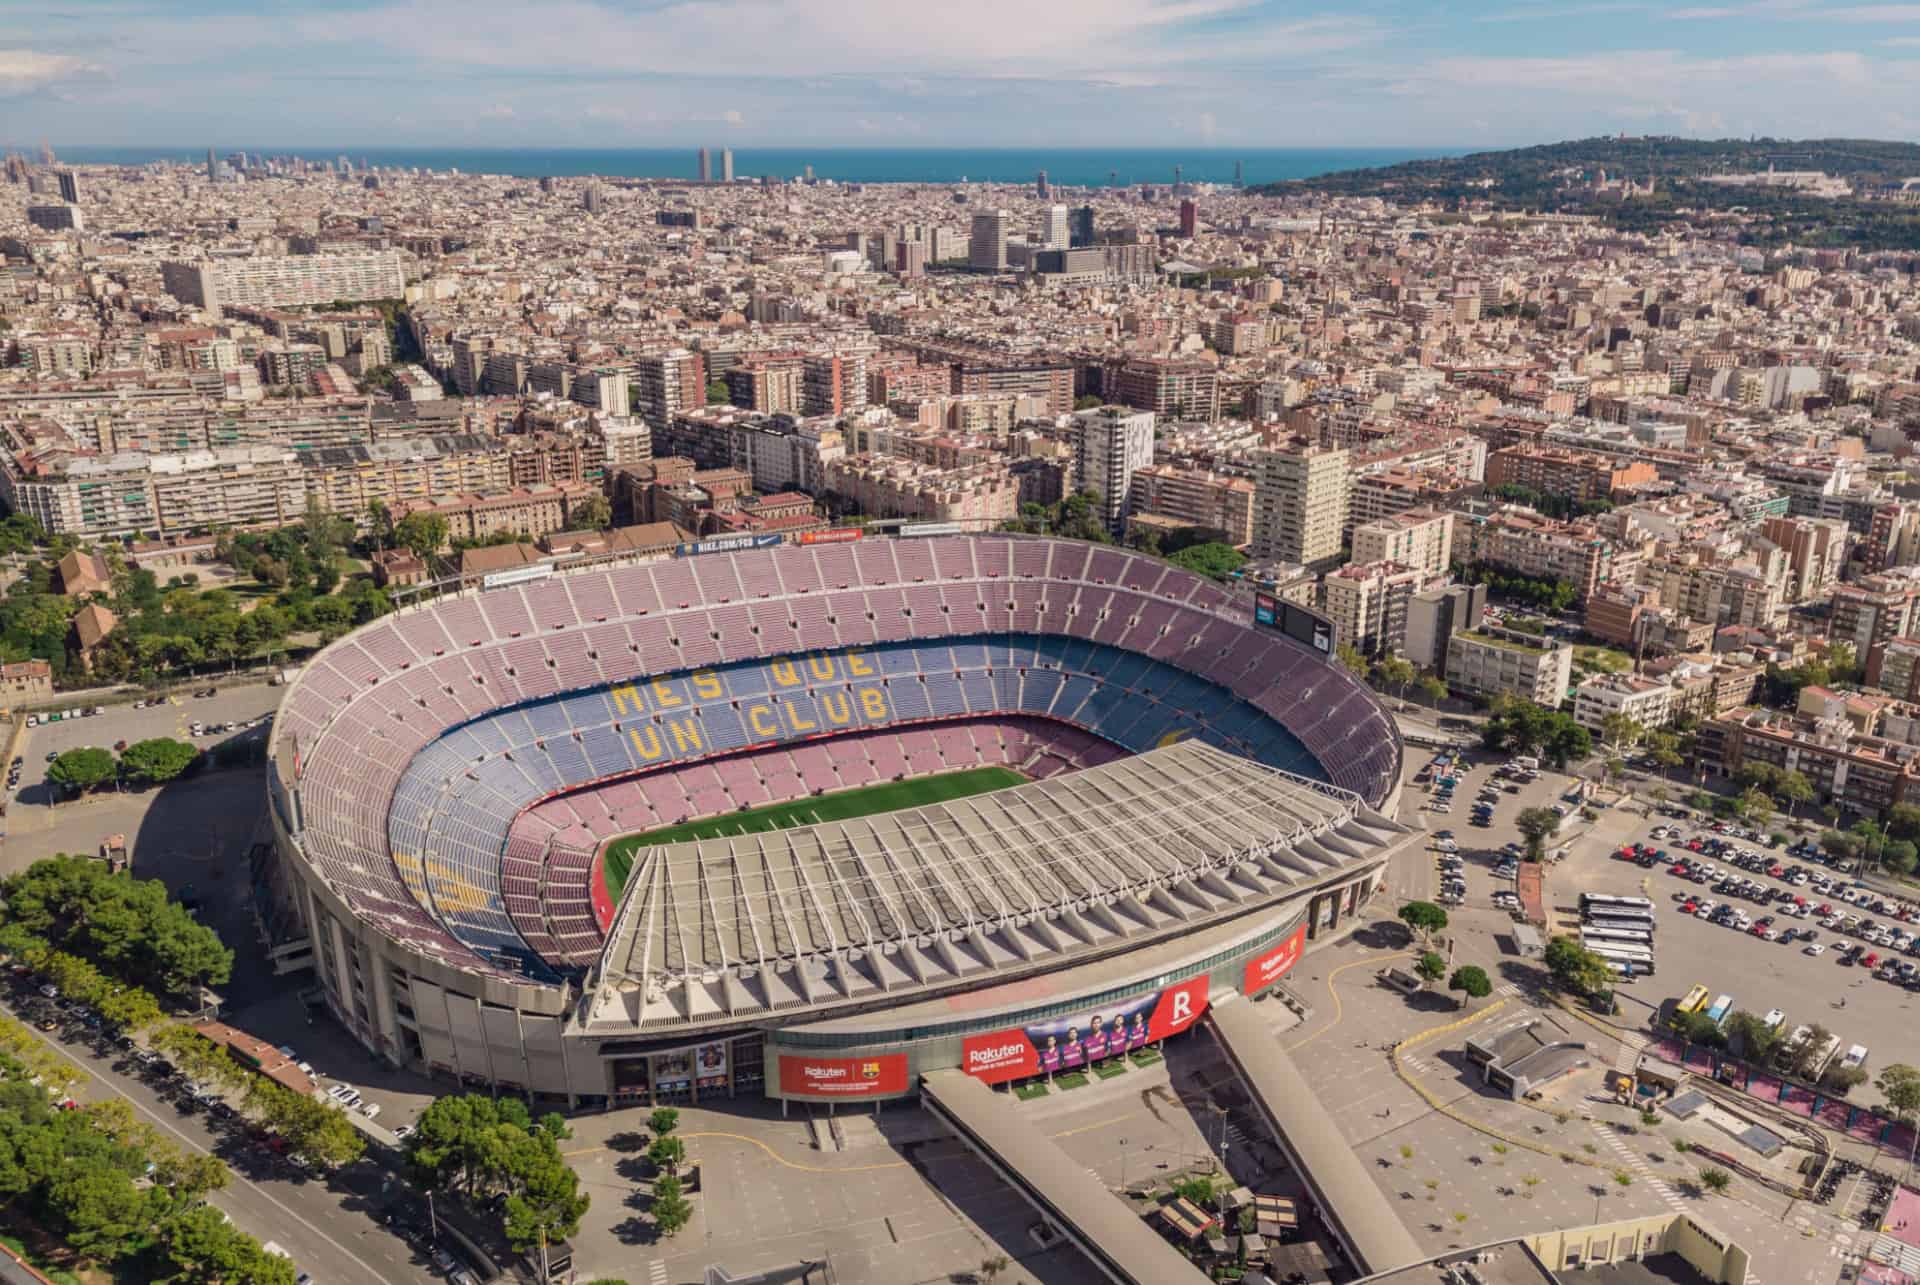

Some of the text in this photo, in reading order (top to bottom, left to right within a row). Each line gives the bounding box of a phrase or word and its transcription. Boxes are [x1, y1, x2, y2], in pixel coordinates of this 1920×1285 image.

[610, 650, 874, 716] MES QUE
[630, 688, 888, 760] UN CLUB
[1173, 991, 1192, 1020] R
[969, 1043, 1025, 1064] Rakuten
[804, 1066, 847, 1079] Rakuten
